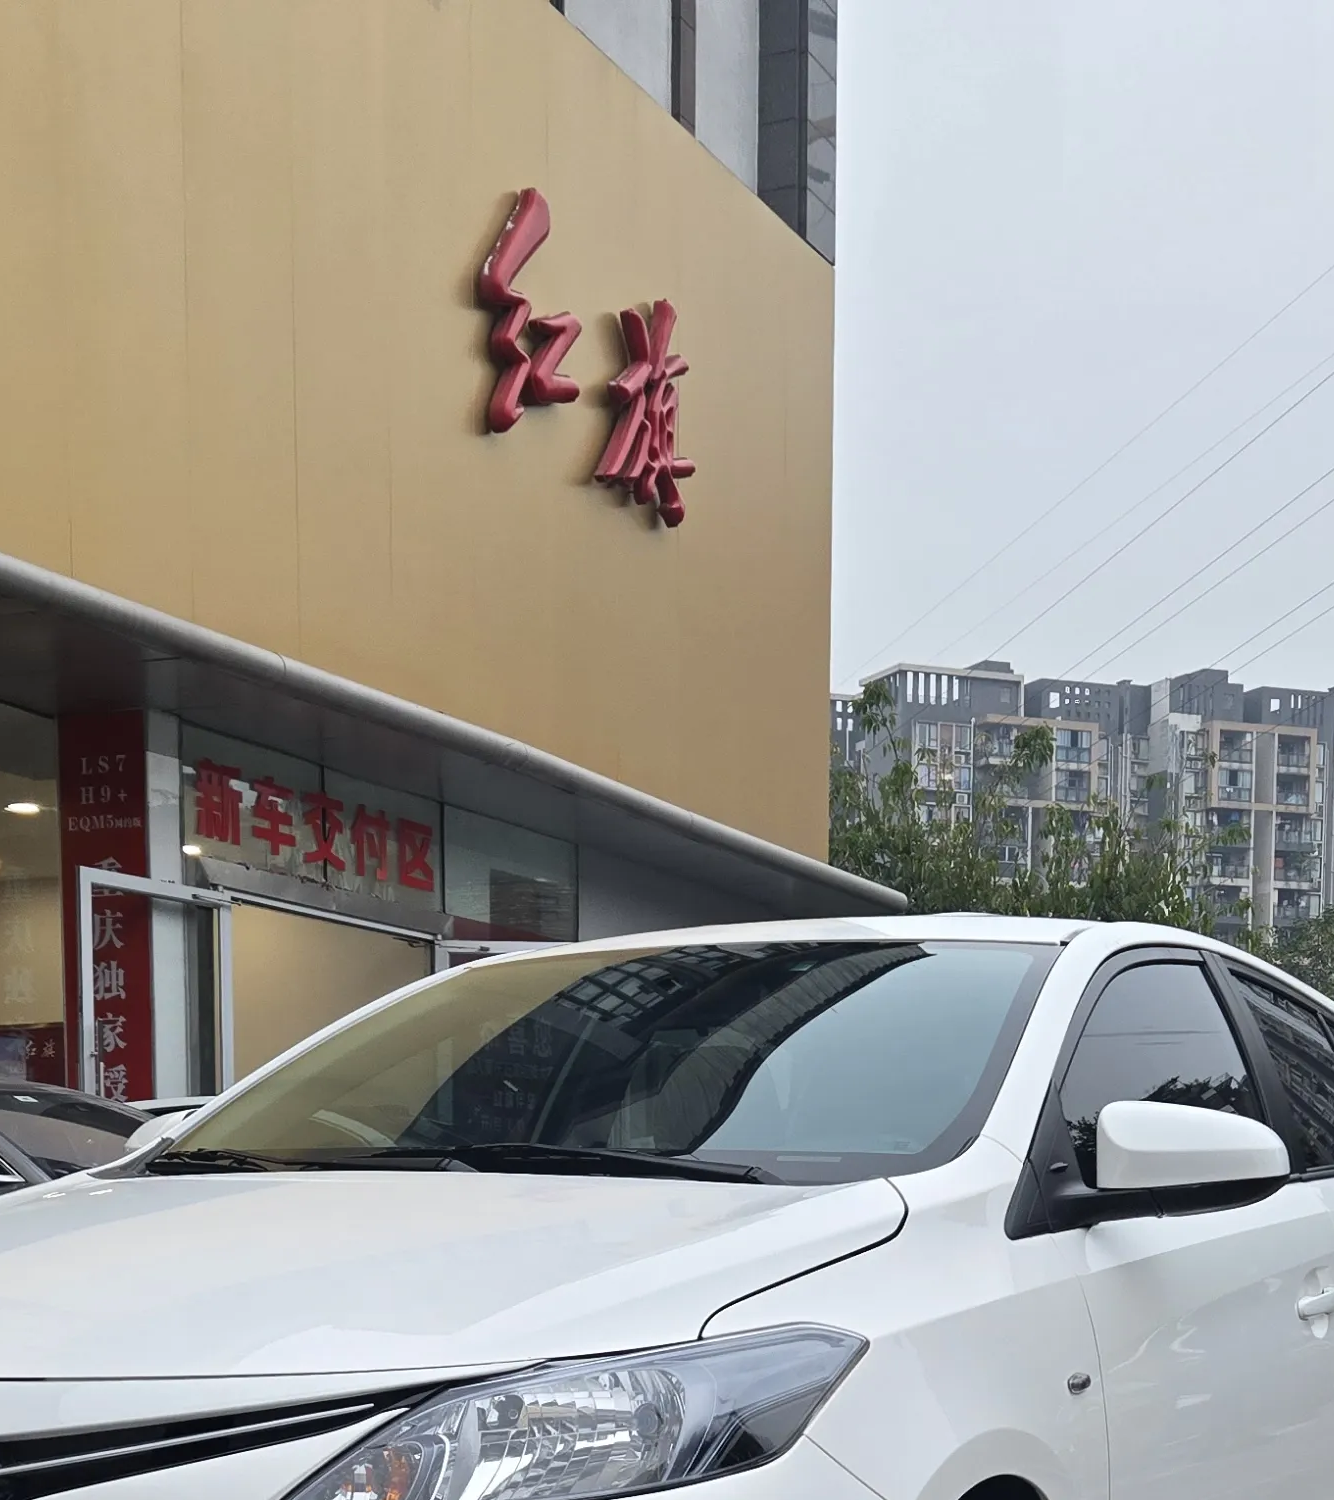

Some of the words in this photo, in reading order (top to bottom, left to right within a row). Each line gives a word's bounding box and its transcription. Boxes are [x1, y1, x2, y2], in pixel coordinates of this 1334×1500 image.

[478, 186, 697, 529] 红旗
[79, 785, 128, 805] H9+
[80, 754, 127, 775] LS7
[195, 757, 435, 892] 新车交付区
